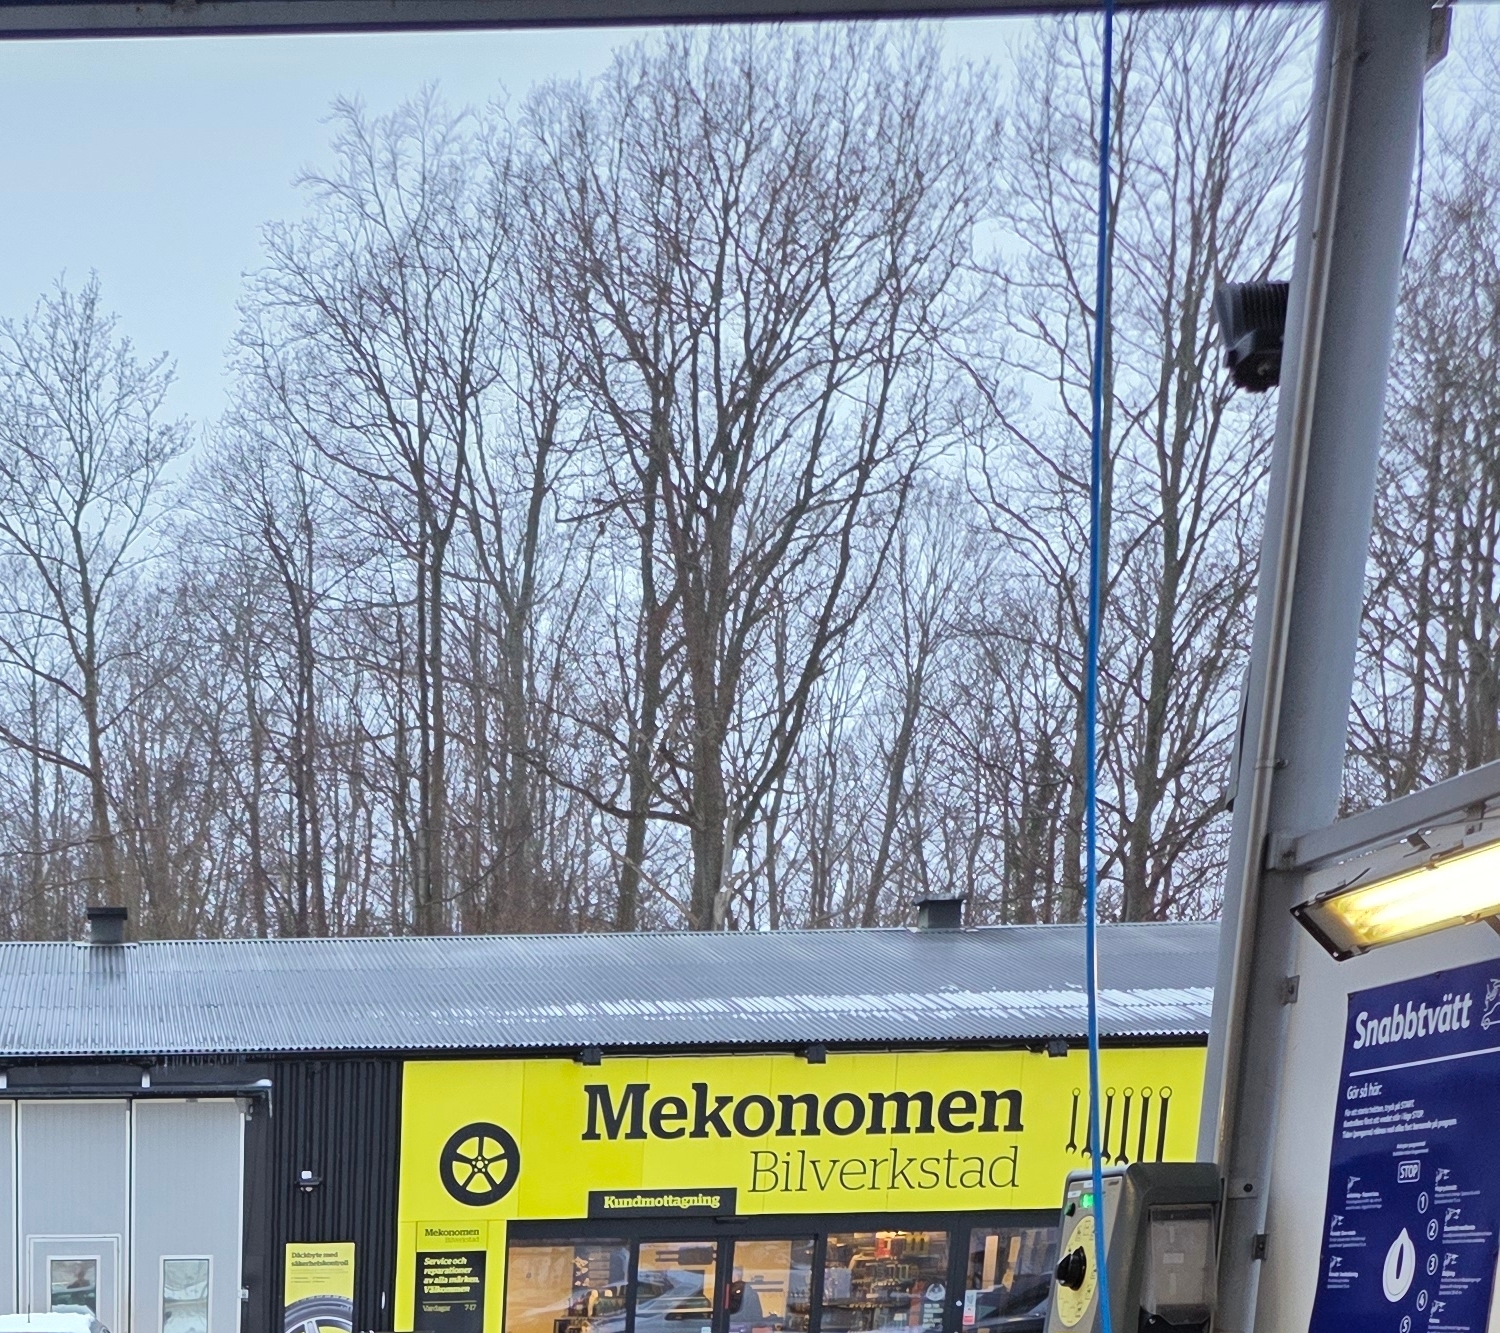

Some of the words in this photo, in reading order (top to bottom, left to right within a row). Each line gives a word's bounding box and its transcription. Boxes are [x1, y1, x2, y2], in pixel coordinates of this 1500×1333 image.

[1353, 992, 1473, 1049] Snabbtvätt
[581, 1082, 1024, 1141] Mekonomen
[747, 1146, 1020, 1194] Bilverkstad
[1399, 1164, 1418, 1179] STOP
[604, 1193, 720, 1209] Kundmottagning
[424, 1229, 479, 1237] Mekonomen
[1429, 1222, 1435, 1236] 2
[1429, 1257, 1436, 1274] 3
[1401, 1319, 1408, 1333] 5
